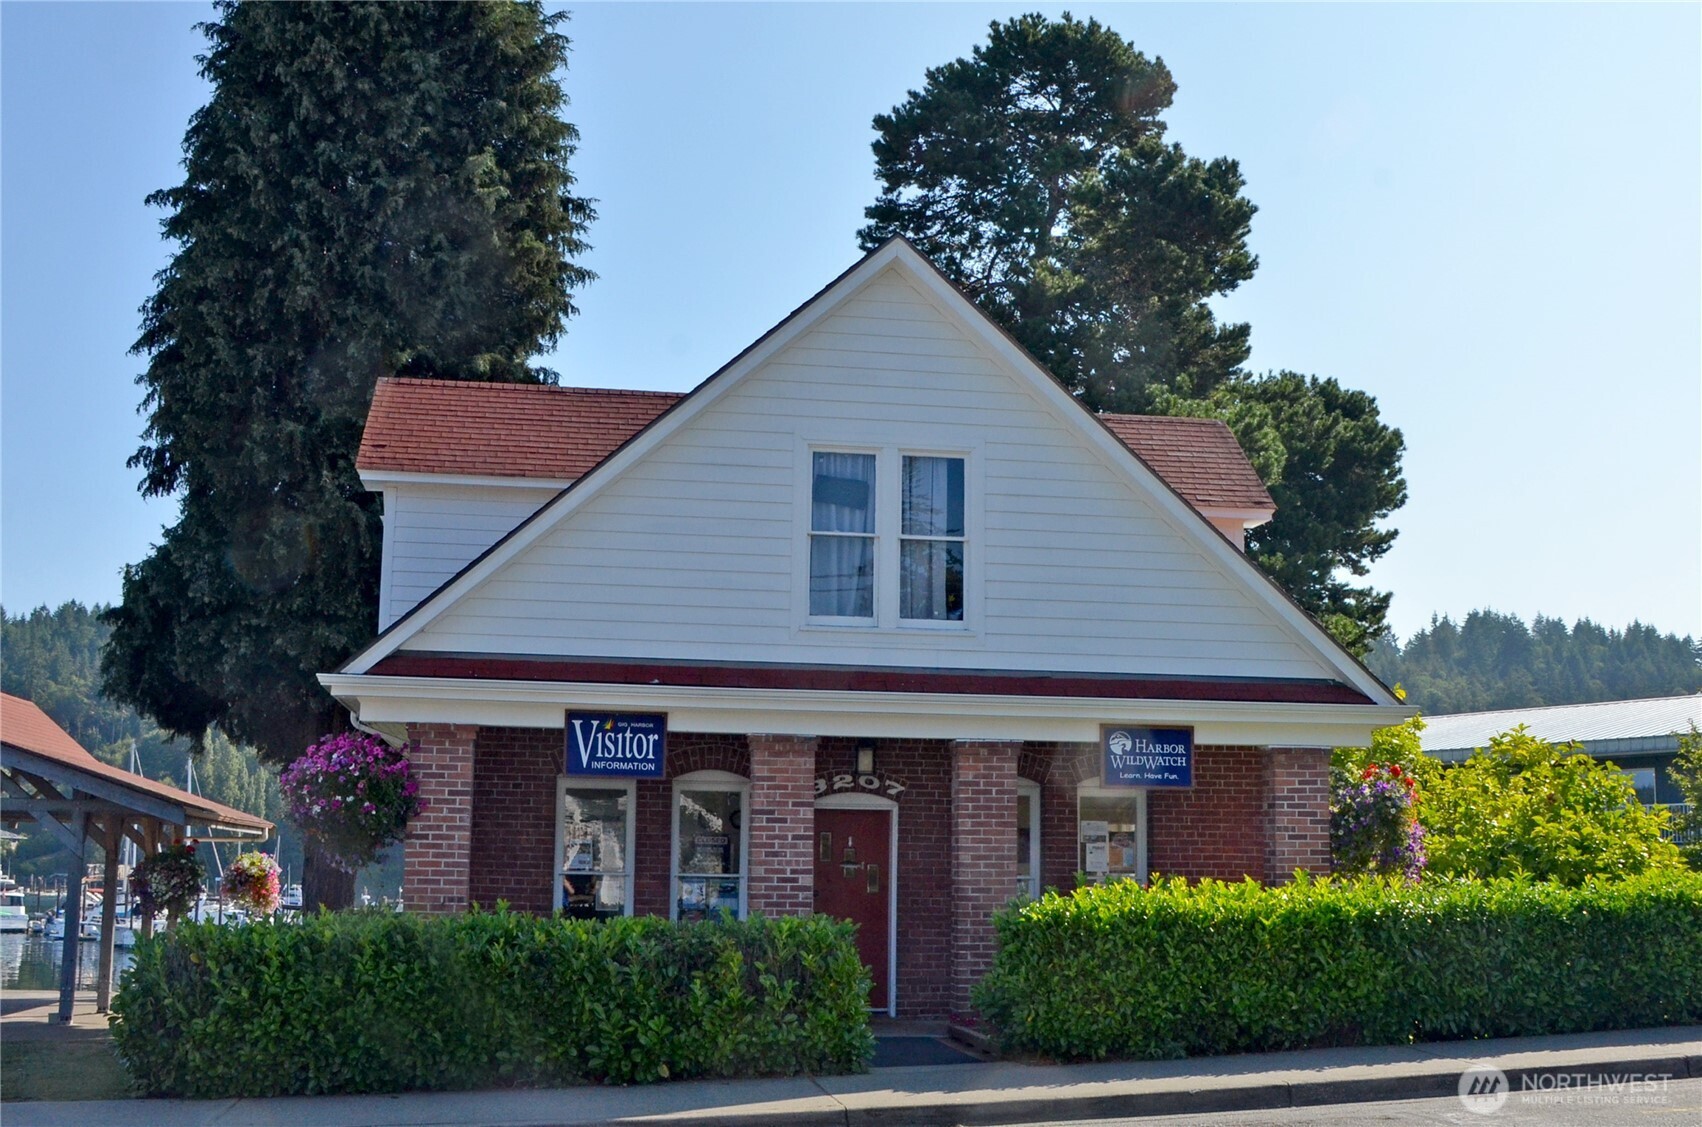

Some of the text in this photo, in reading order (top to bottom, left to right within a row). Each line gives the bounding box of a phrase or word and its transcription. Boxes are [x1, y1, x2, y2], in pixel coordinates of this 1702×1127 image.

[571, 719, 659, 769] Visitor
[591, 761, 655, 771] INFORMATION
[1144, 772, 1163, 780] Have
